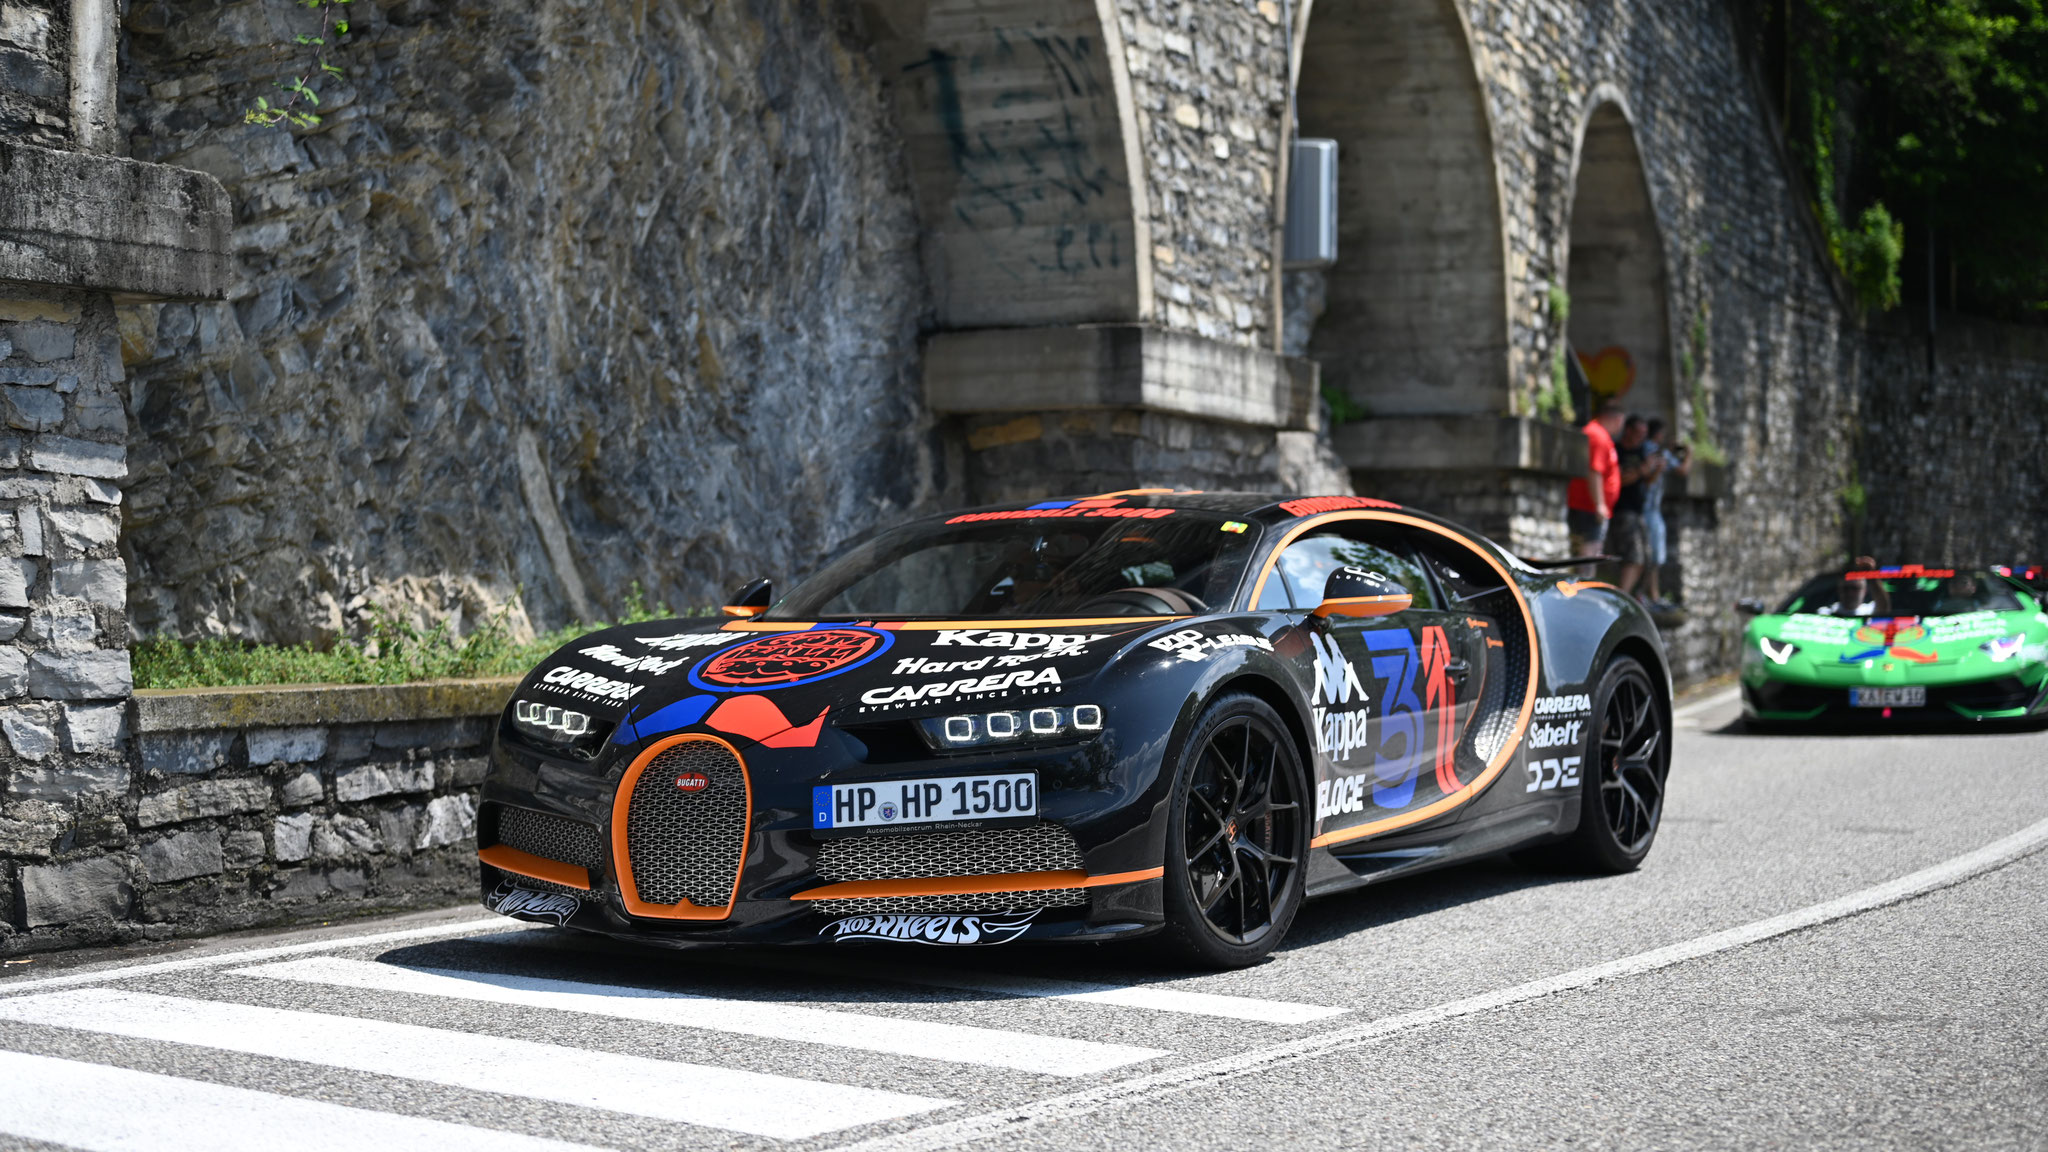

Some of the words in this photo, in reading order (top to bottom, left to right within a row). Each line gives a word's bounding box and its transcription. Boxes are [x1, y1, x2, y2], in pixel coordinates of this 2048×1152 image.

[892, 656, 994, 675] Hard
[993, 644, 1086, 667] Rock
[543, 666, 645, 700] CARRERA
[861, 667, 1062, 705] CARRERA
[859, 698, 941, 712] EYEWEAR
[956, 691, 1008, 702] SINCE
[1022, 686, 1062, 695] 1956
[1534, 693, 1592, 715] CARRERA
[1313, 706, 1367, 762] Kappa
[1529, 720, 1581, 749] Sabelt
[677, 778, 706, 787] BUGATTI
[819, 812, 827, 822] D
[836, 787, 876, 822] HP
[902, 783, 942, 818] HP
[952, 778, 1033, 815] 1500
[866, 824, 932, 834] Automobilzentrum
[935, 821, 983, 831] Rhein-Neckar
[834, 917, 872, 937] HOT
